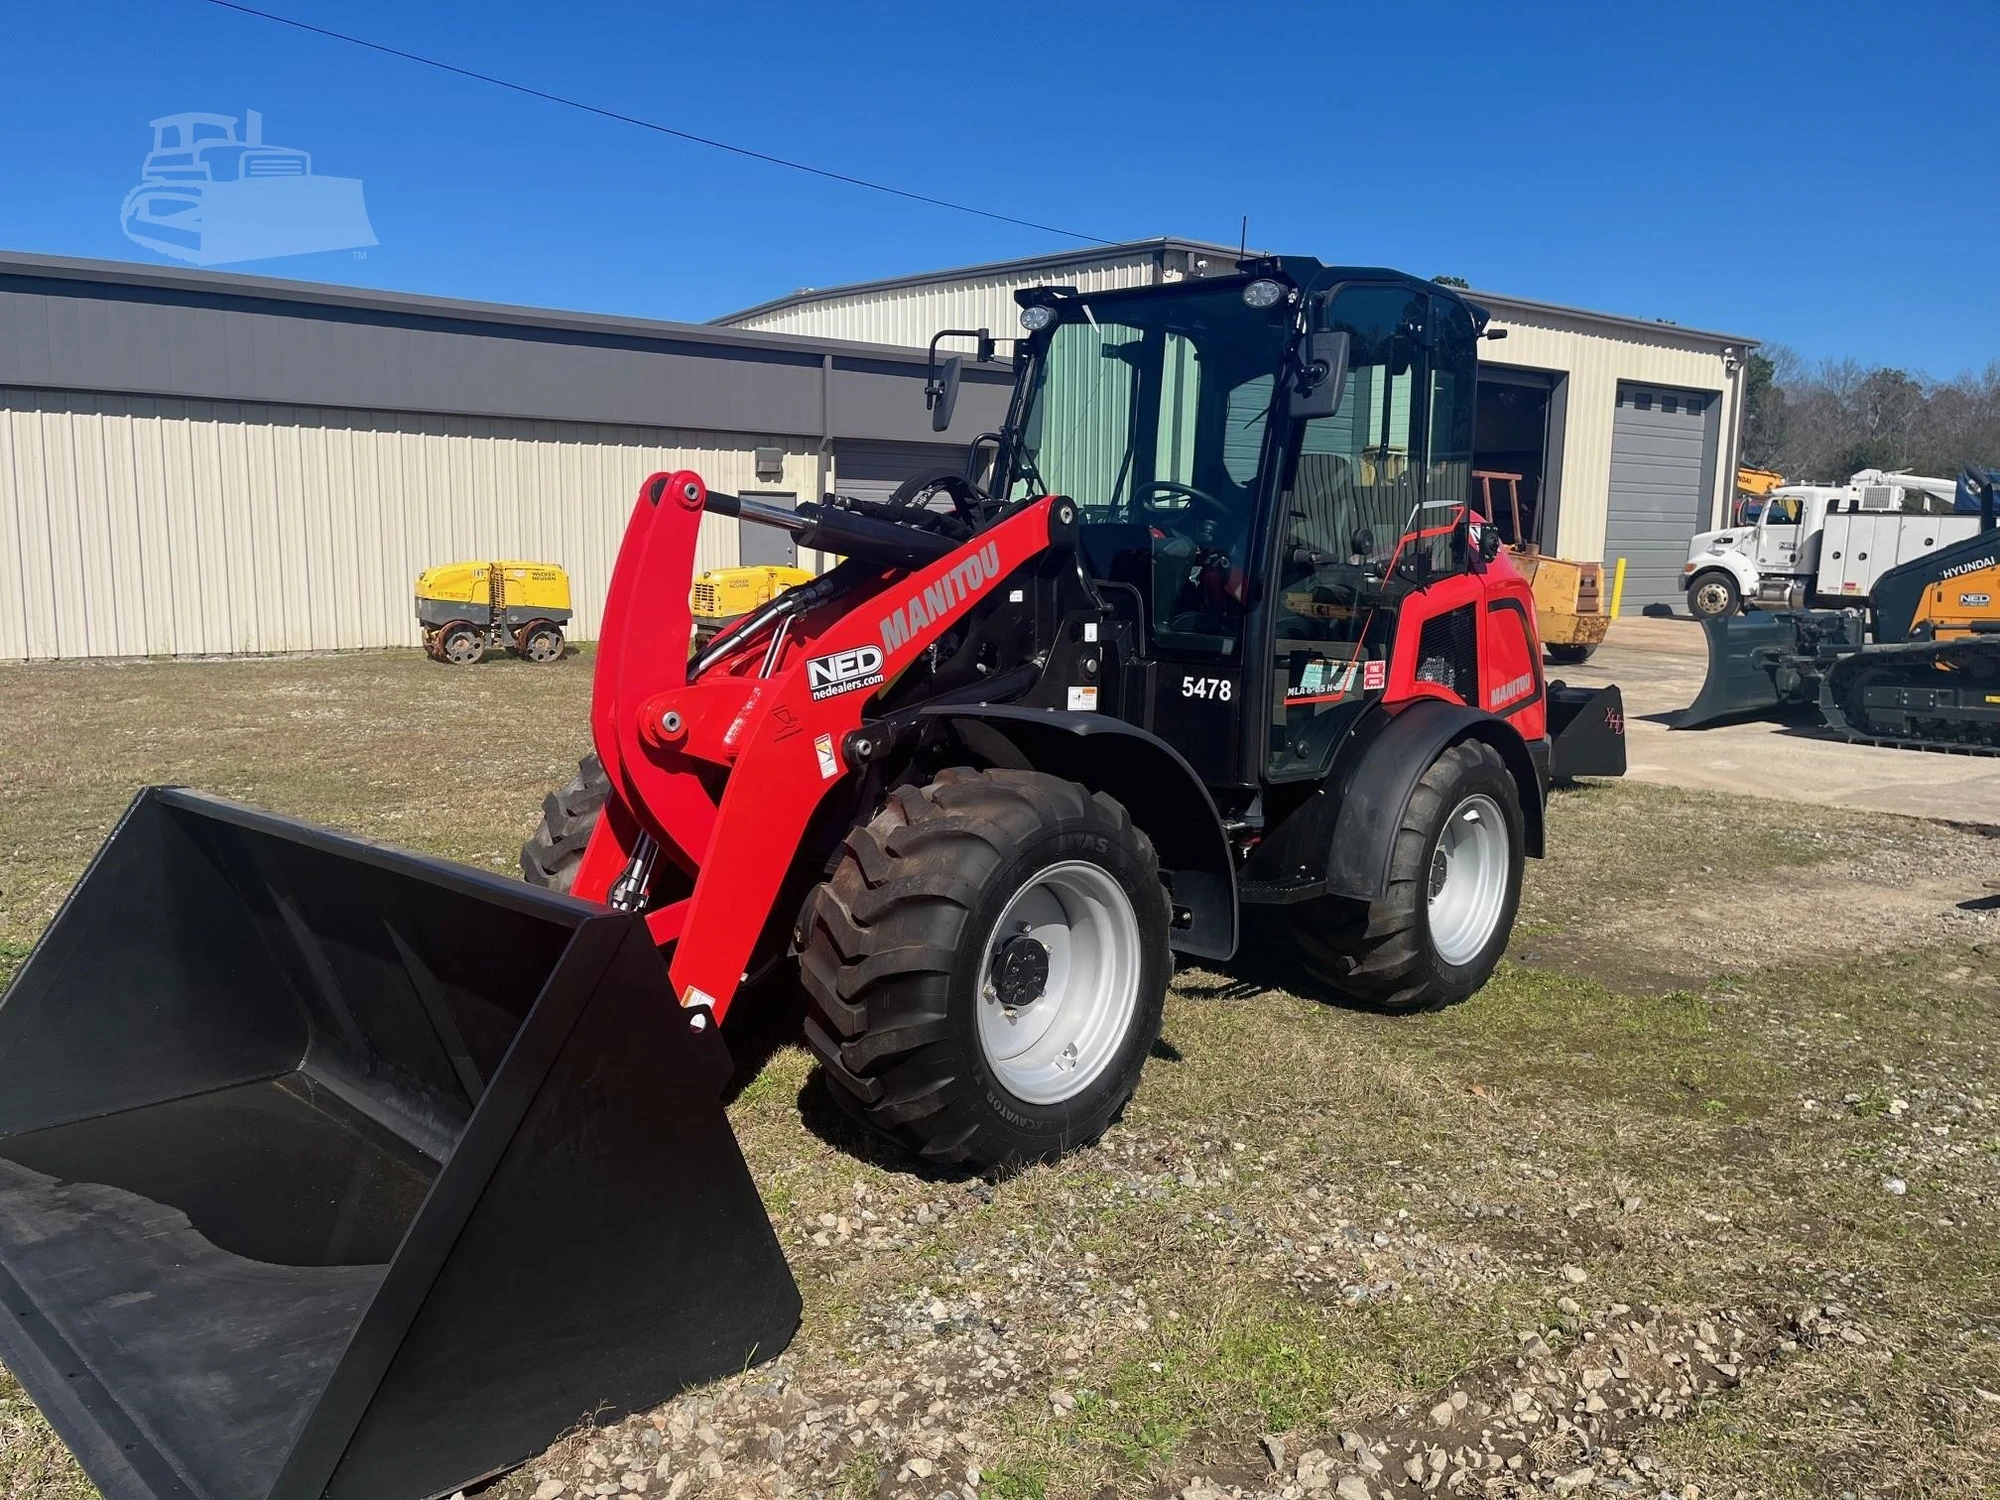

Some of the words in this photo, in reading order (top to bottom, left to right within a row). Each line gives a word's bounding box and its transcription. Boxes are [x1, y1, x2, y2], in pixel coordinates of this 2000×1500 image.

[1943, 556, 1996, 579] HYUNDAI
[879, 540, 1000, 656] MANITOU
[1960, 594, 1990, 602] NED
[808, 646, 883, 688] NED
[813, 673, 884, 700] nedealers.com
[1181, 676, 1231, 701] 5478
[1287, 687, 1305, 696] MLA
[1491, 673, 1531, 707] MANITOU
[1604, 707, 1625, 735] XHD
